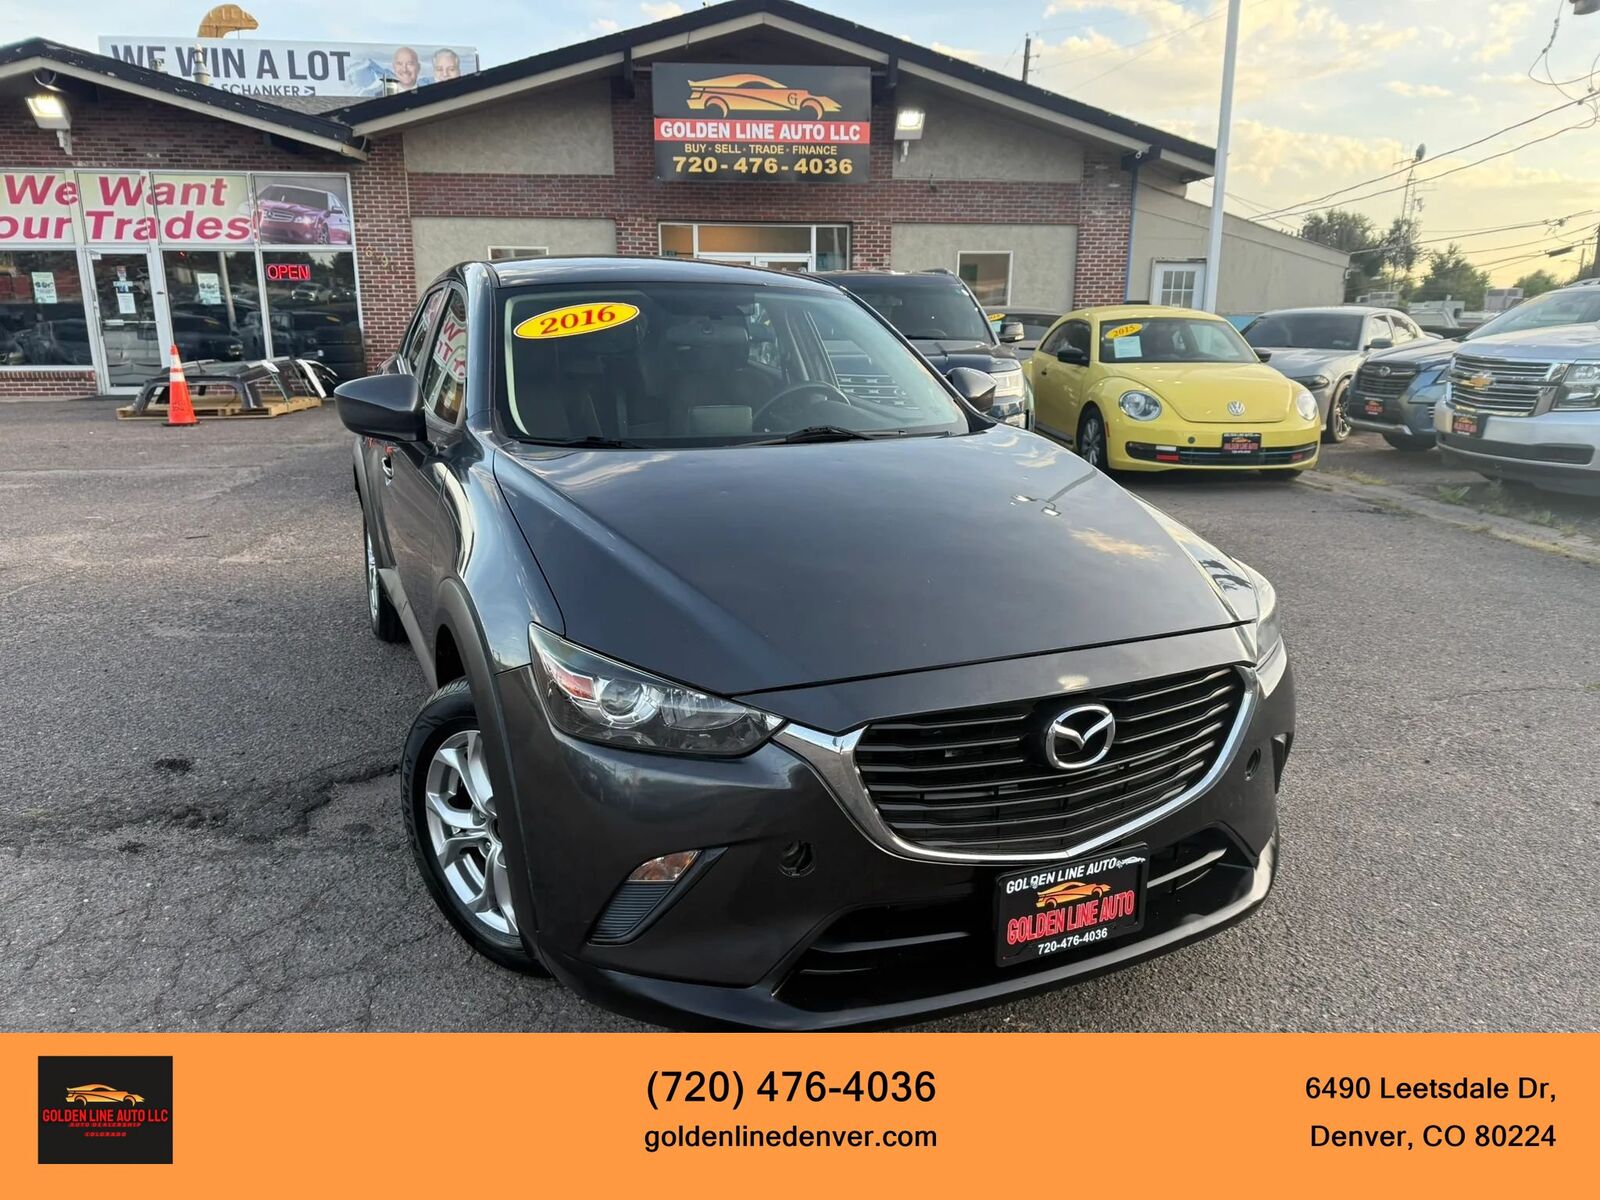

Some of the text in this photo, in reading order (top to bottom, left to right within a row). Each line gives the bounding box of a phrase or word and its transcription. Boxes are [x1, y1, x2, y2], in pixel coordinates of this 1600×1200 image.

[174, 46, 247, 79] WIN
[256, 50, 279, 79] A
[288, 50, 351, 81] LOT
[660, 121, 861, 141] GOLDEN LINE AUTO LLC
[684, 143, 838, 155] BUY SELL TRADE FINANCE
[4, 174, 228, 207] We Want
[267, 265, 310, 280] OPEN
[540, 304, 616, 335] 2016
[1113, 325, 1136, 337] 2015
[1006, 857, 1117, 894] GOLDEN LINE AUTO
[1006, 889, 1135, 945] GOLDEN LINE AUTO
[1038, 928, 1108, 955] 720-476-4036
